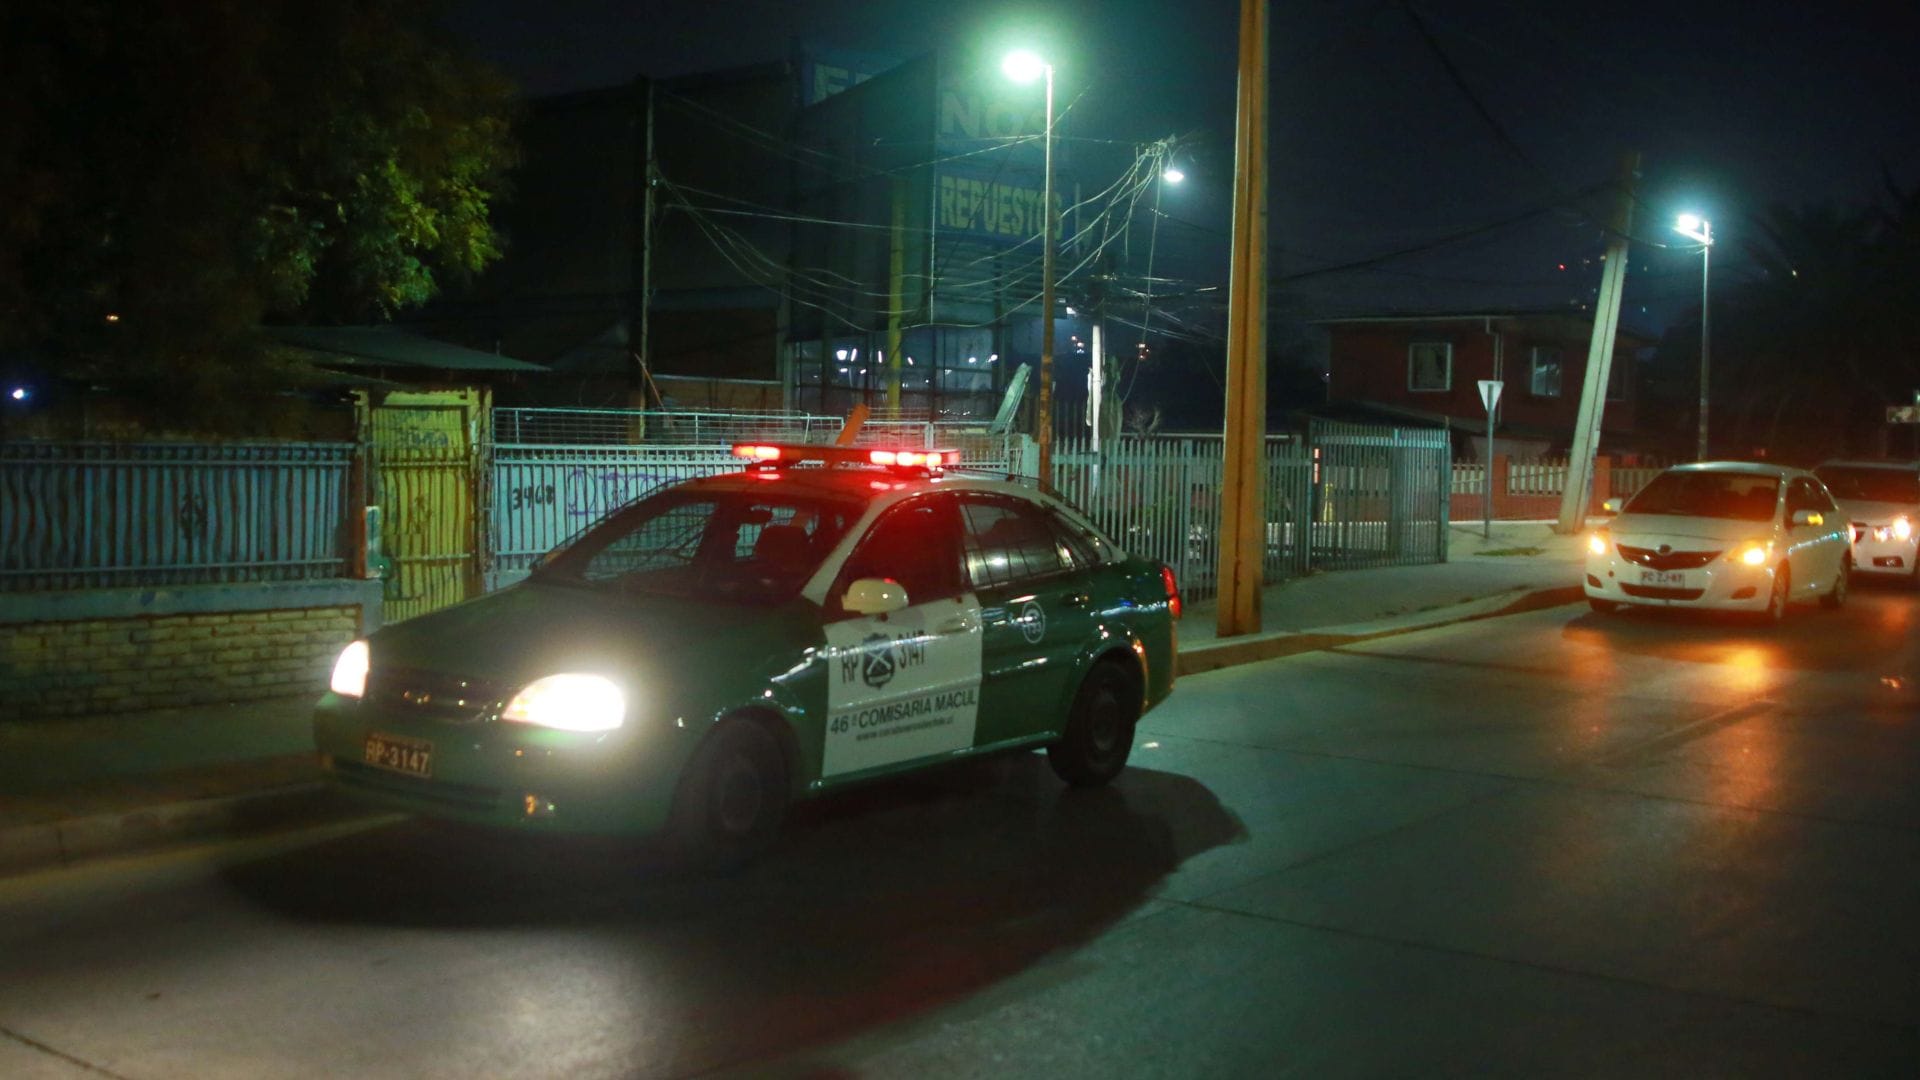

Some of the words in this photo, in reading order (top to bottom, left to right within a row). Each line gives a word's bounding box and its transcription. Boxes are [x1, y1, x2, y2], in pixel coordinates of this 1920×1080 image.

[941, 175, 1064, 241] REPUESTOS
[859, 698, 932, 728] COMISARIA
[934, 690, 977, 711] MACUL
